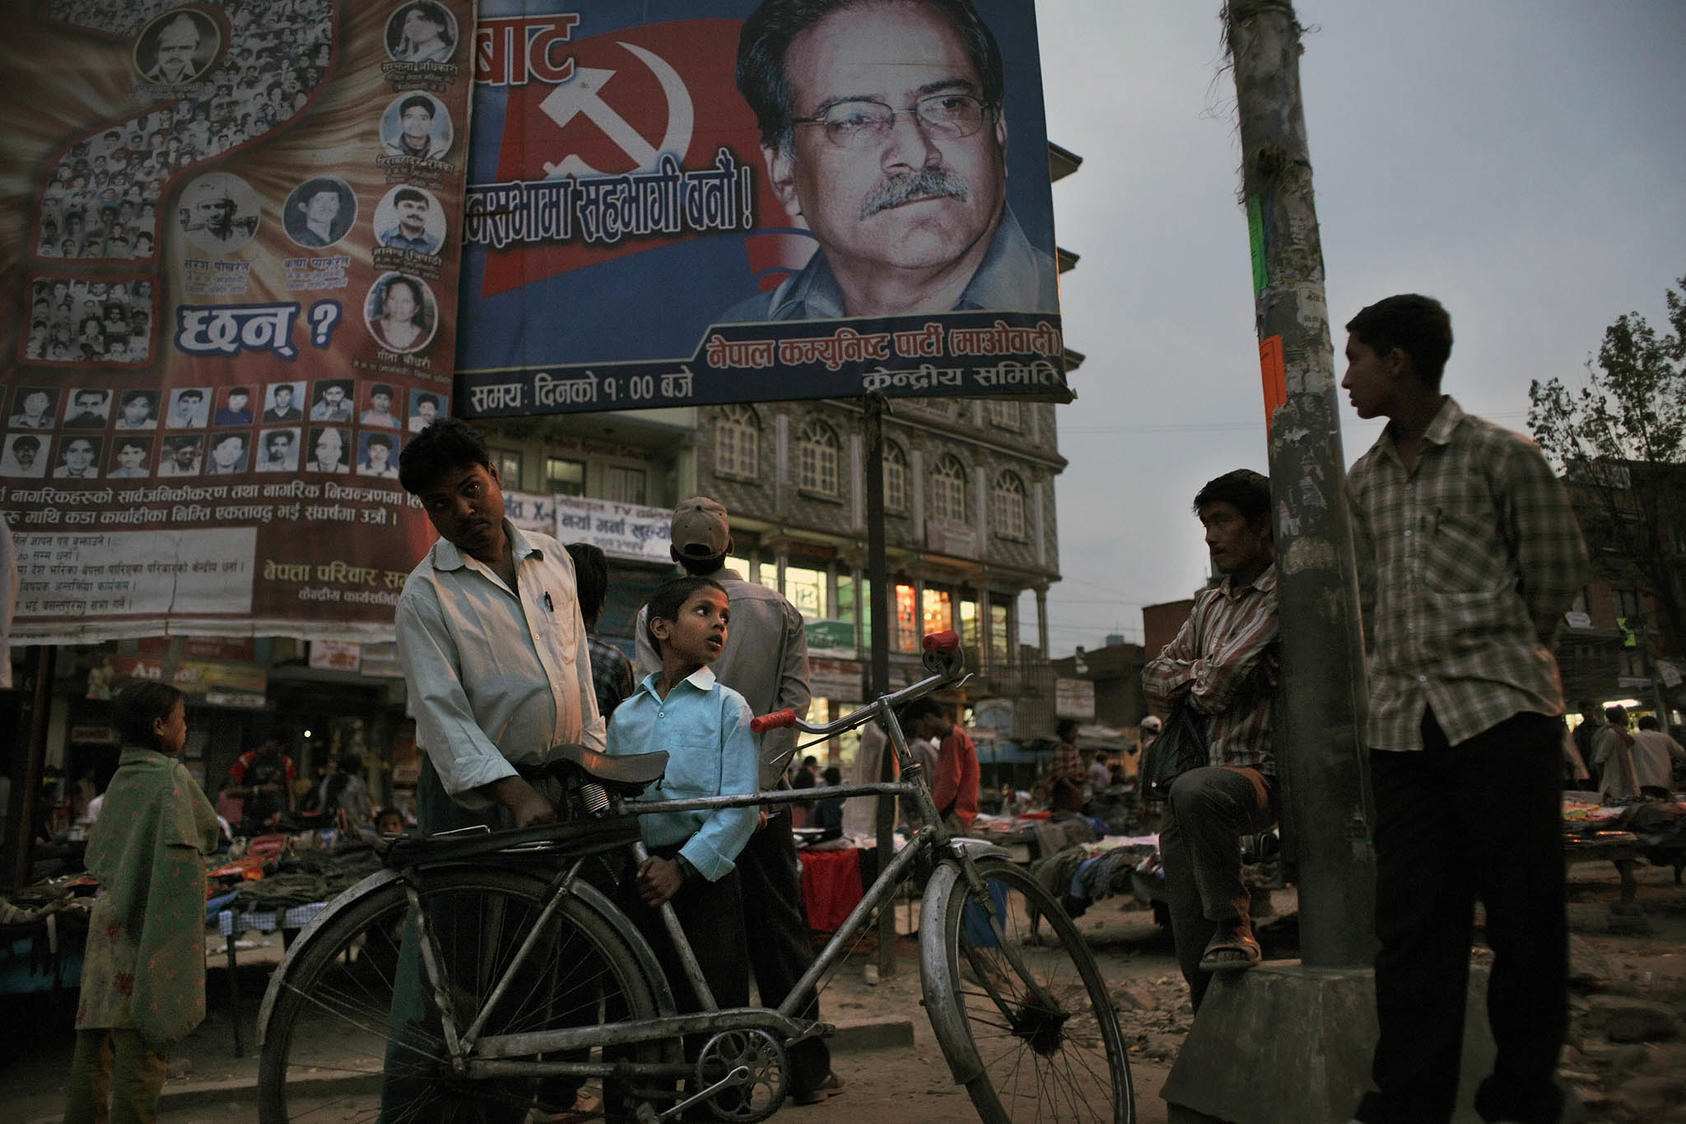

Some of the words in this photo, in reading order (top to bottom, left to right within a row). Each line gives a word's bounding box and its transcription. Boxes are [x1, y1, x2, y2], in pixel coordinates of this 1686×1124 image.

[577, 152, 687, 241] सहभागी
[311, 302, 340, 346] ?
[707, 335, 775, 369] नेपाल
[779, 327, 891, 373] कम्युनिष्ट
[894, 321, 945, 358] पार्टी
[948, 320, 1063, 358] (माओवादी)
[534, 372, 600, 407] दिनको
[661, 365, 694, 398] बजे
[972, 360, 1059, 388] समिति
[231, 483, 259, 500] तथा
[264, 479, 320, 499] नागरिक
[25, 506, 61, 525] माथि
[65, 509, 96, 525] कडा
[317, 560, 380, 587] परिवार
